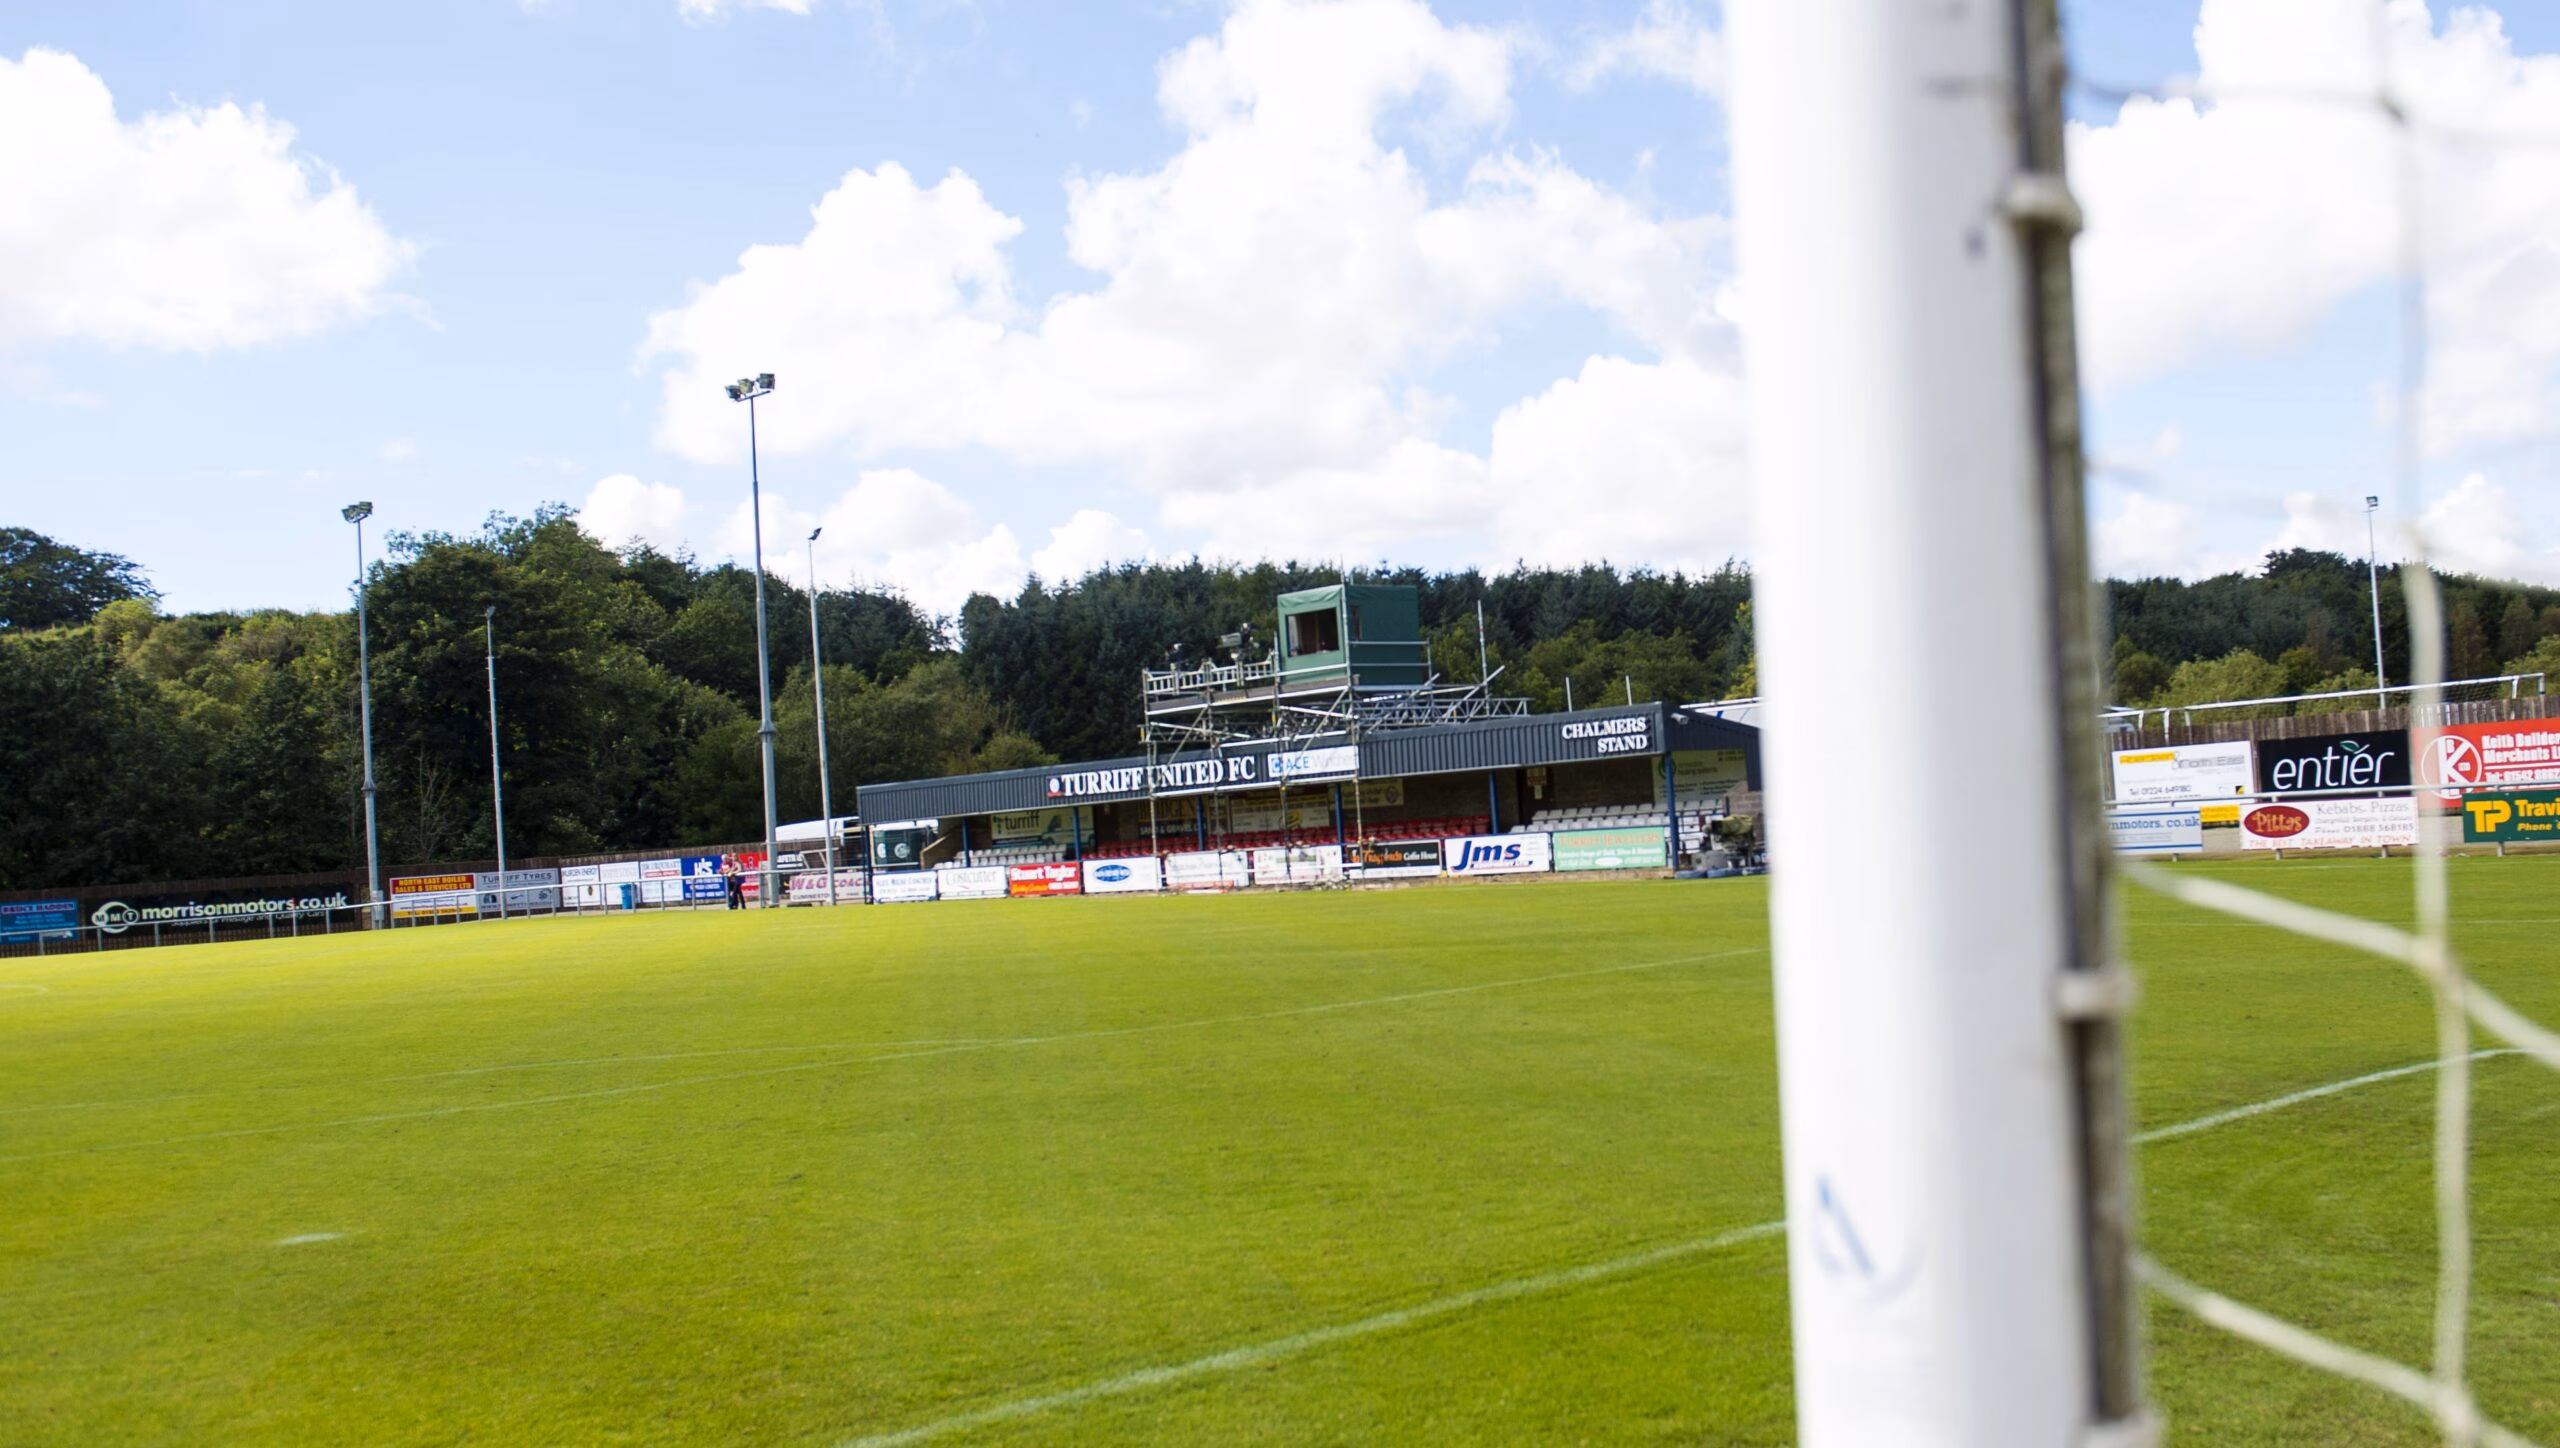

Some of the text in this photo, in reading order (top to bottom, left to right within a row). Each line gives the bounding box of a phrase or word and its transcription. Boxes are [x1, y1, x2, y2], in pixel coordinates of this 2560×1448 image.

[1562, 717, 1647, 739] CHALMERS
[1597, 735, 1648, 753] STAND
[2482, 734, 2514, 749] Keith
[1286, 756, 1310, 769] ACE
[2483, 747, 2550, 763] Merchants
[1061, 756, 1256, 796] TURRIFF UNITED FC
[2370, 801, 2409, 813] Pizzas
[2252, 812, 2303, 833] Pittas
[2465, 800, 2511, 833] TP
[2517, 822, 2552, 831] Phone
[399, 876, 466, 887] NORTH EAST BOILER
[482, 872, 552, 883] TURIFF TYRES
[790, 878, 806, 890] W
[395, 885, 416, 893] SALES
[425, 883, 458, 892] SERVICES
[459, 882, 472, 890] LTD
[142, 891, 349, 920] morrisonmotors.co.uk
